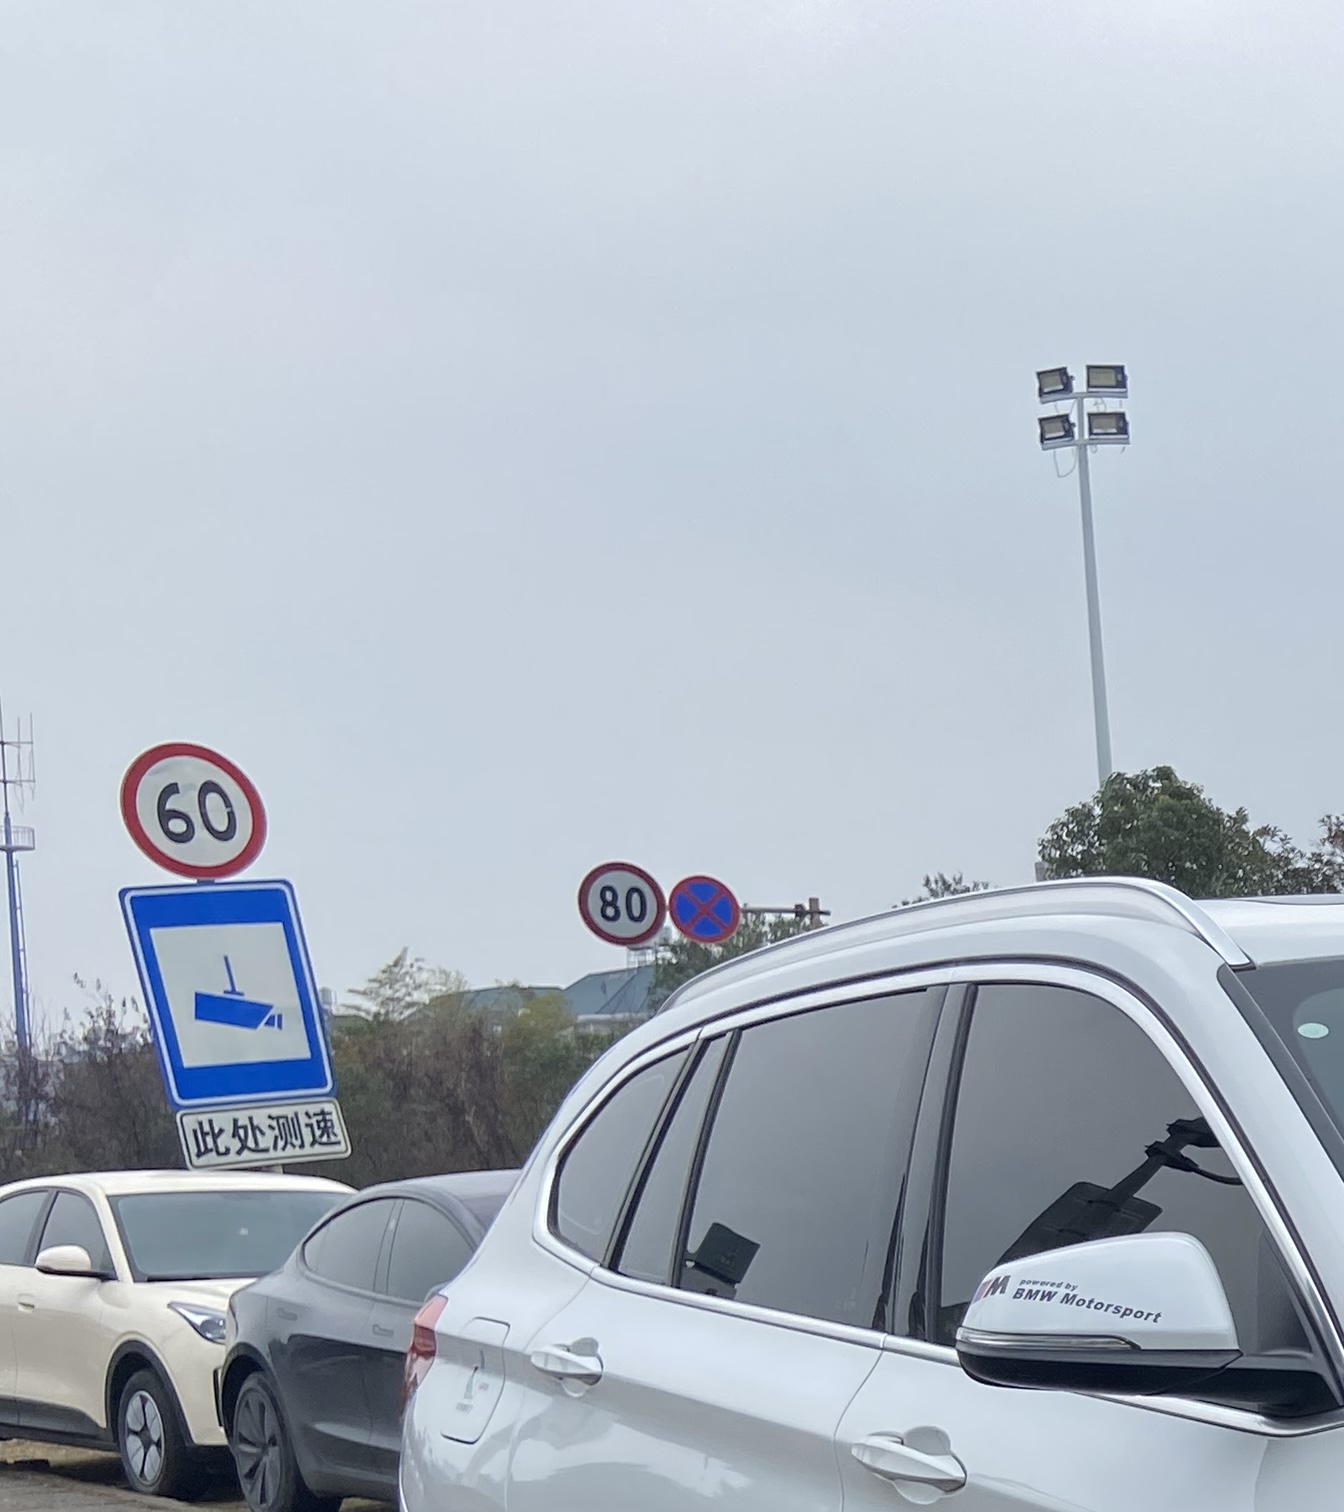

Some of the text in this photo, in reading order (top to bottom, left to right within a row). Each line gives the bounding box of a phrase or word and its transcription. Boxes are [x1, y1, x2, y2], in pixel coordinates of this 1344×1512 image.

[156, 780, 238, 844] 60
[600, 885, 647, 922] 80
[192, 1108, 341, 1159] 此处测速
[1019, 1278, 1078, 1292] powered by
[1012, 1288, 1162, 1324] BMW Motorsport
